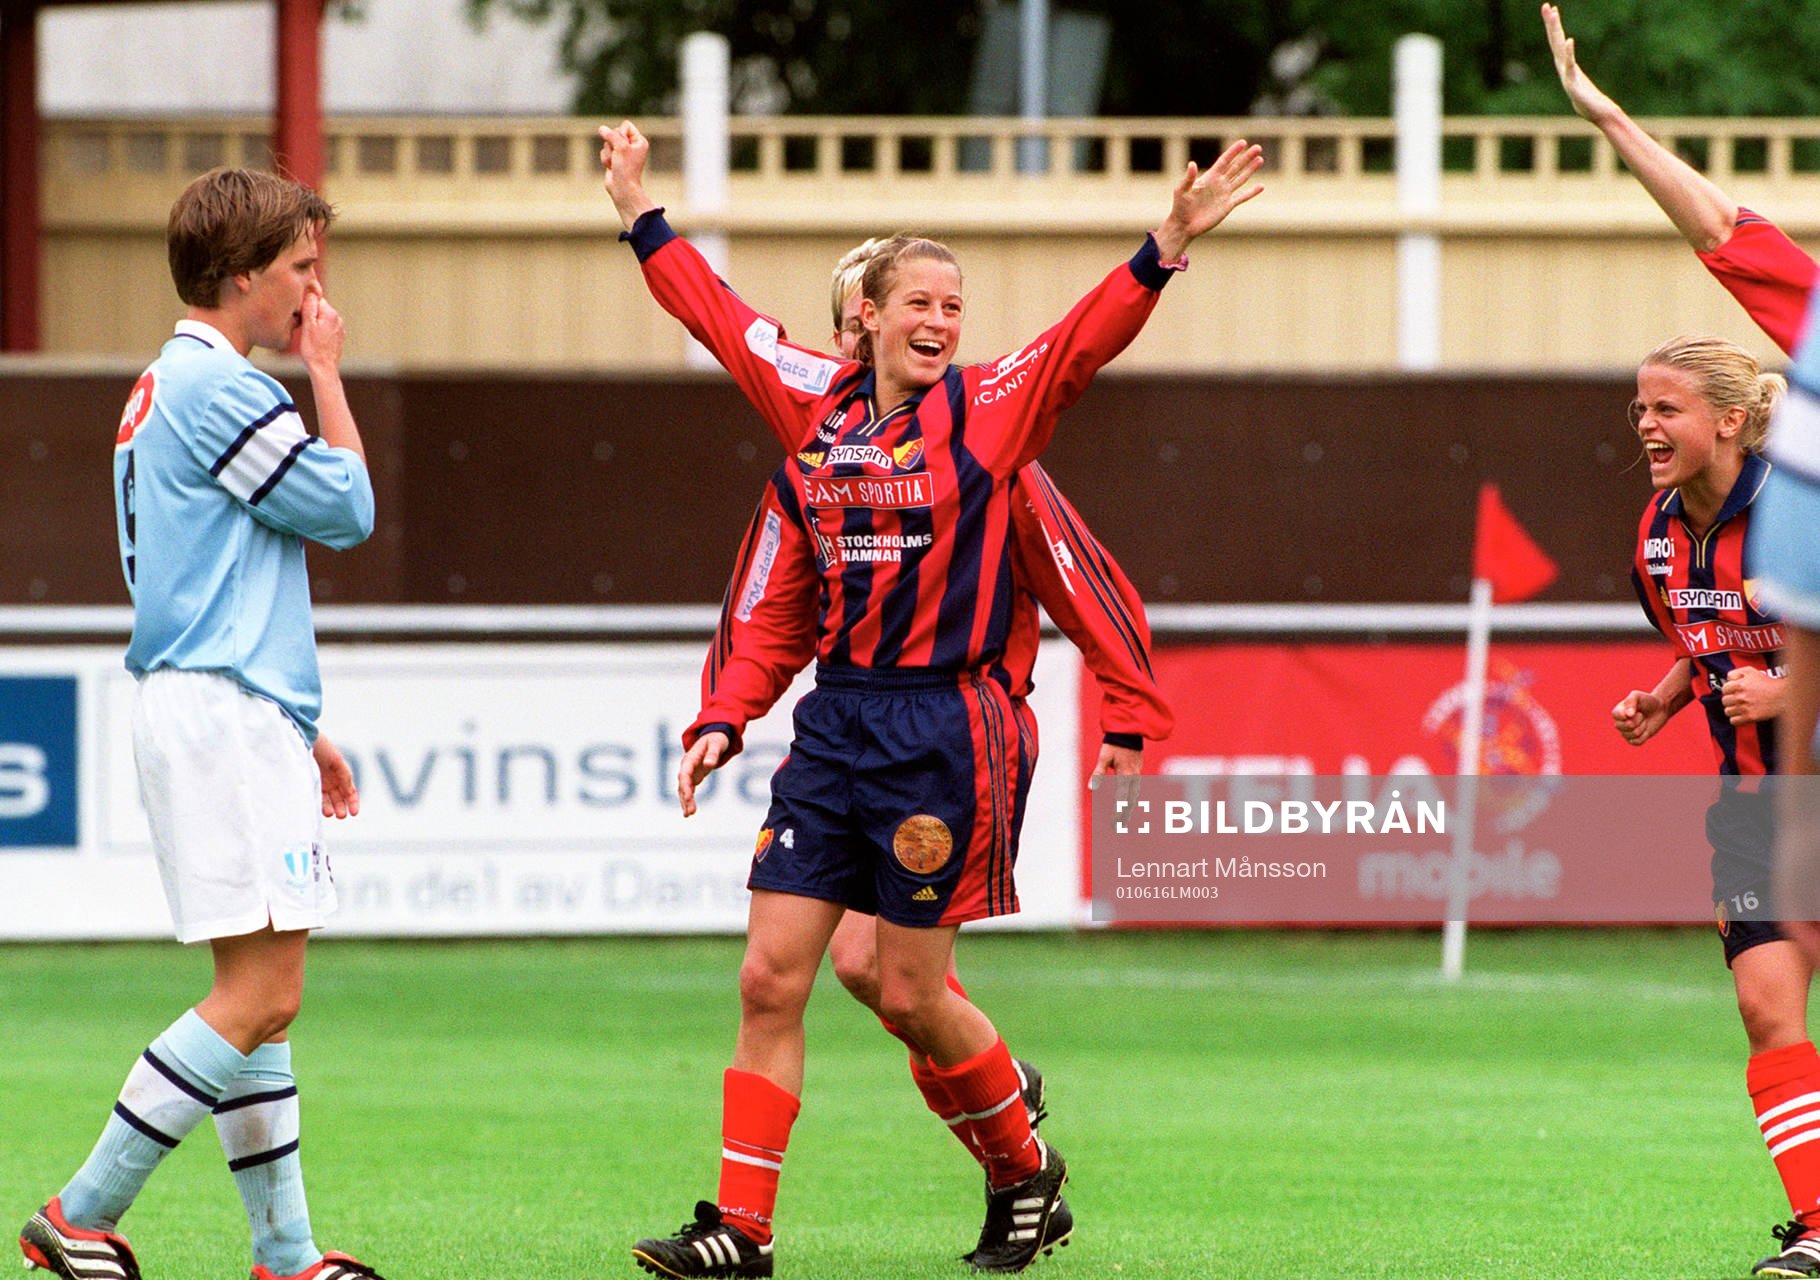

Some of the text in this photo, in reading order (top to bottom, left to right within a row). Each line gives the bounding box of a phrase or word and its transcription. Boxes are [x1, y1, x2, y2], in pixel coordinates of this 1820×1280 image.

[828, 446, 890, 468] SYNSAM
[858, 479, 924, 504] SPORTIA
[835, 533, 933, 548] STOCKHOLMS
[840, 549, 902, 562] HAMNAR
[1679, 590, 1741, 608] SYNSAM
[1715, 625, 1783, 651] SPORTIA
[779, 828, 795, 850] 4
[1731, 891, 1760, 914] 16
